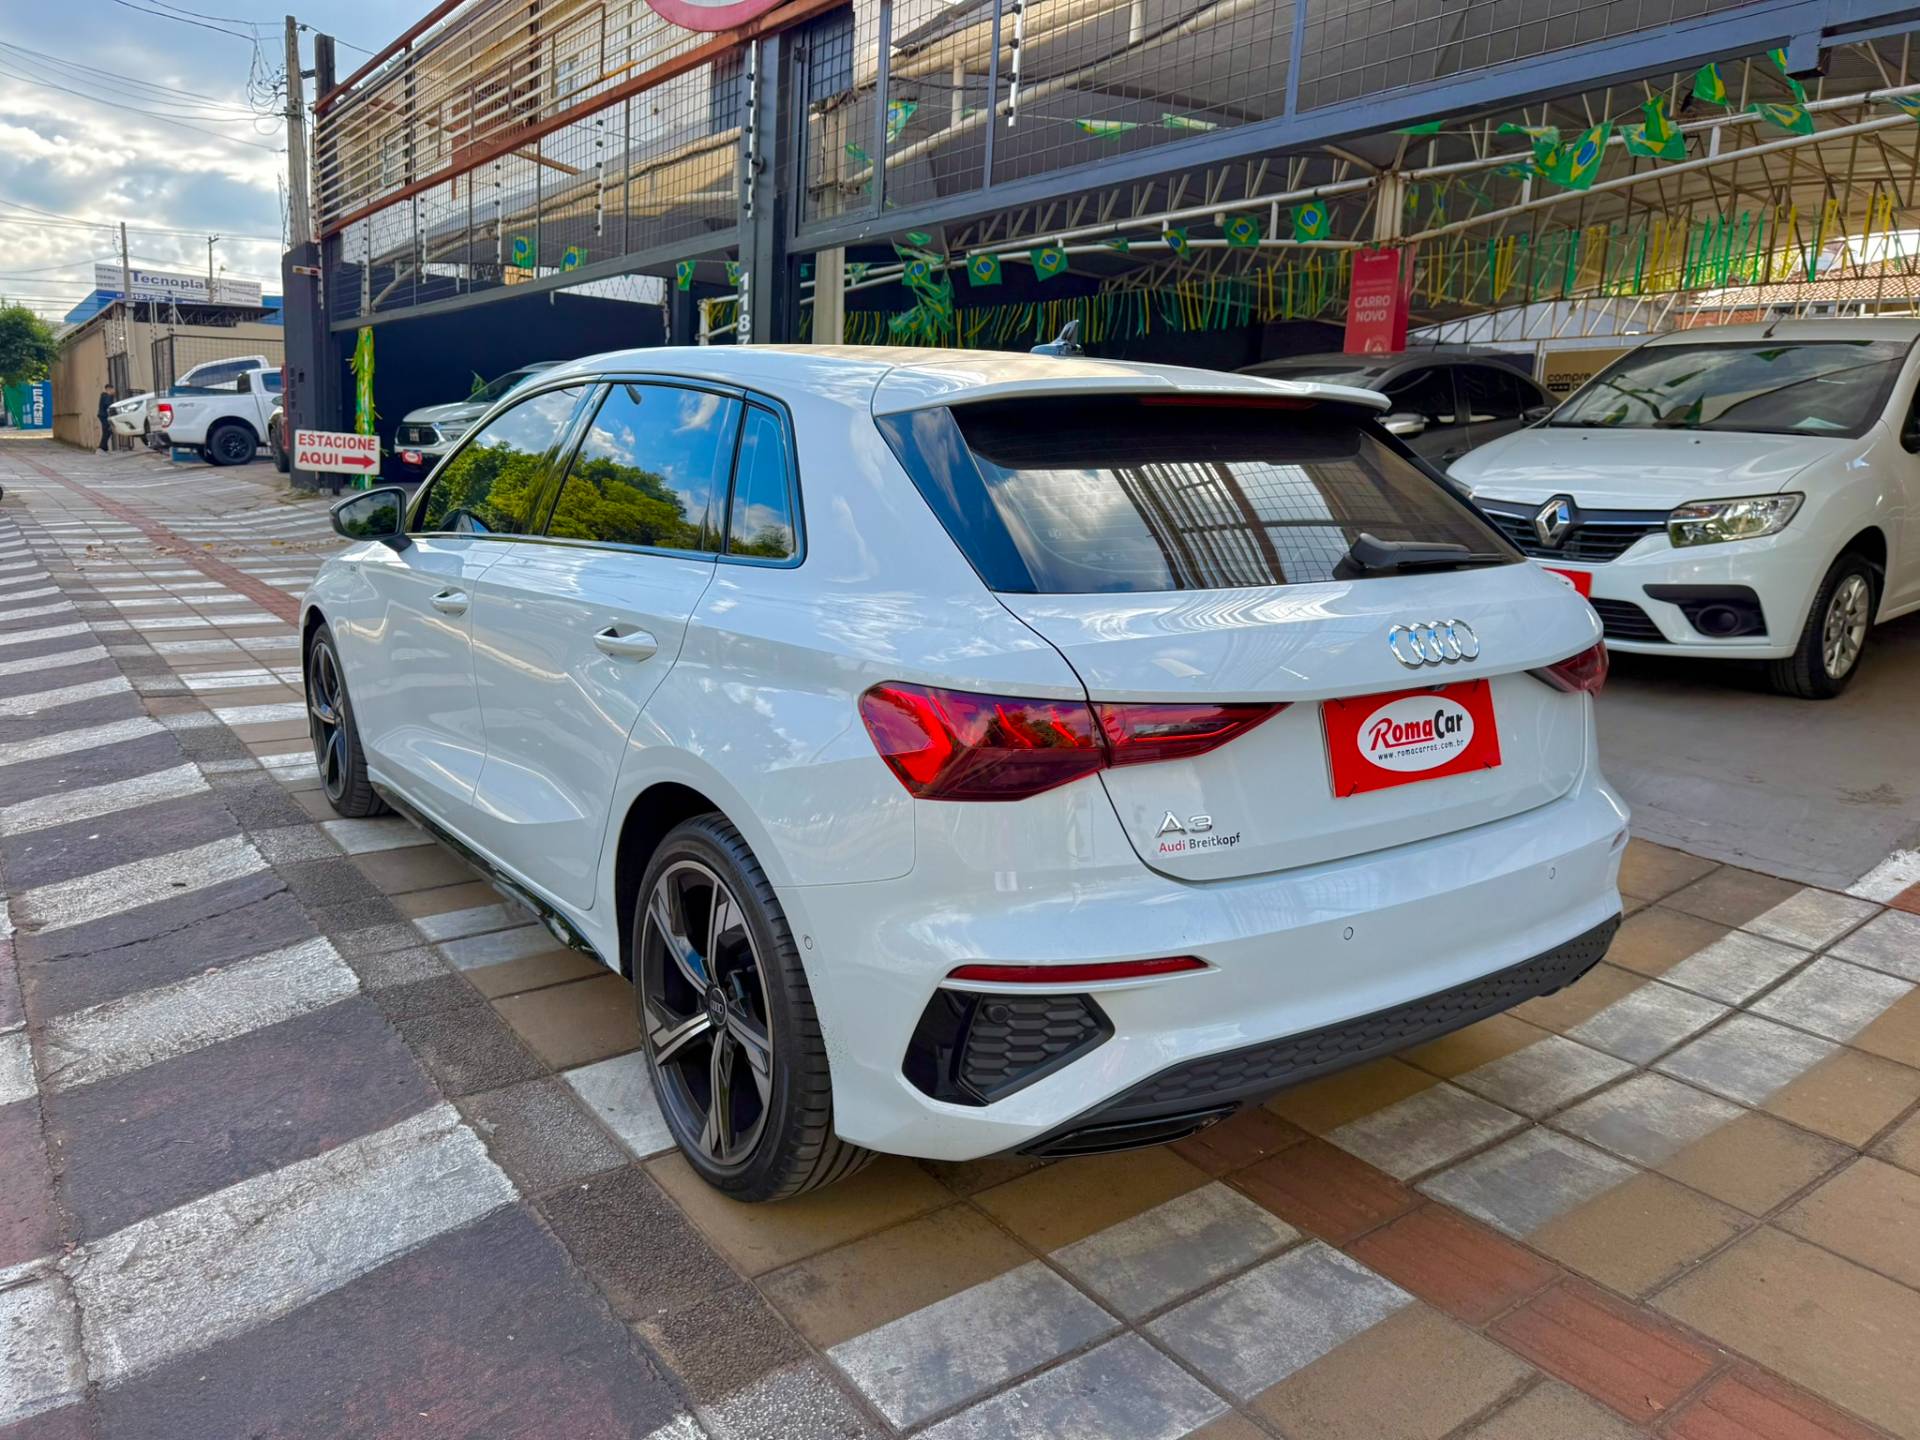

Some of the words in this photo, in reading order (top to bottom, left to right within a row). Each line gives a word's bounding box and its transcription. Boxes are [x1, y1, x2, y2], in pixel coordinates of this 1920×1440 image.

[1355, 295, 1391, 309] CARRO
[1356, 310, 1388, 323] NOVO
[298, 433, 376, 451] ESTACIONE
[299, 451, 339, 466] AQUI
[1368, 709, 1463, 751] RomaCar
[1378, 738, 1465, 761] www.romacarros.com.br
[1155, 810, 1213, 838] A3
[1159, 839, 1186, 853] Audi
[1188, 831, 1241, 850] Breitkopf
